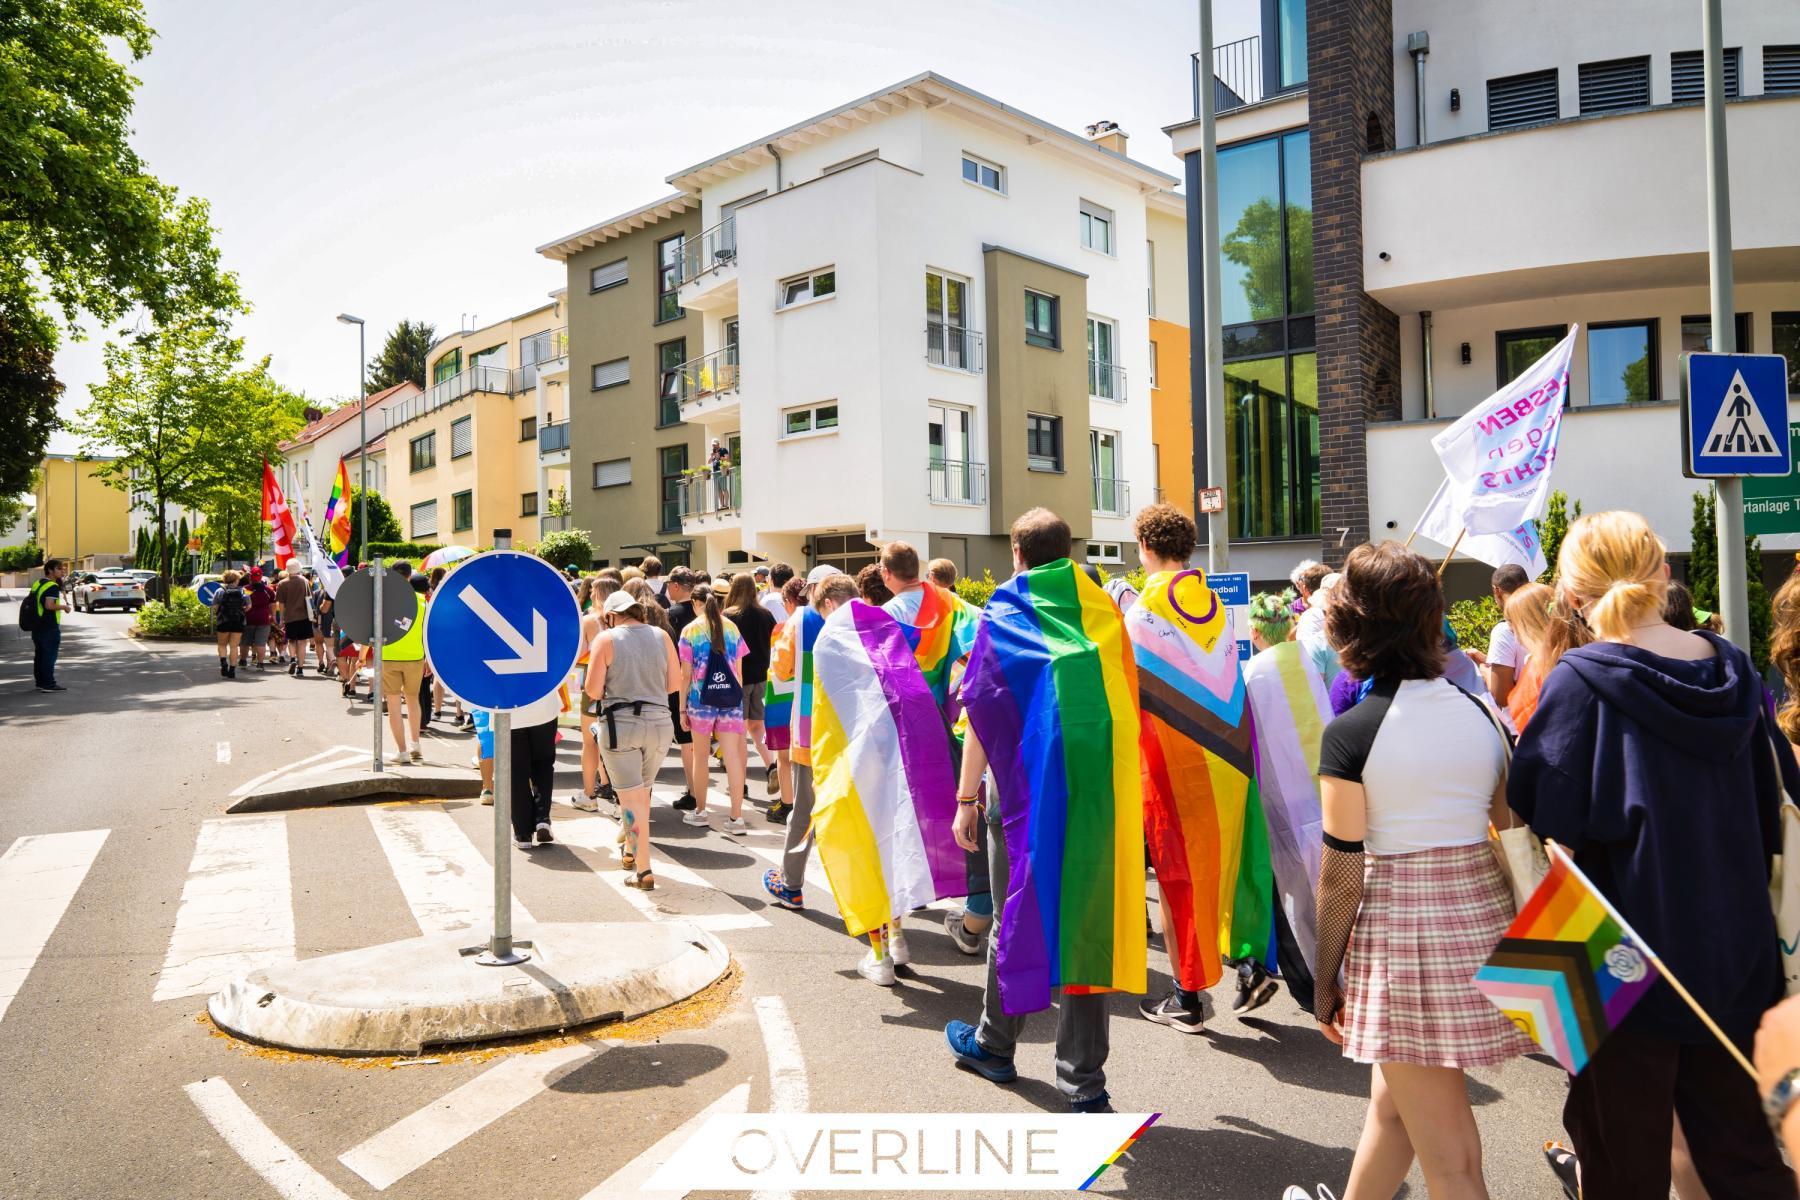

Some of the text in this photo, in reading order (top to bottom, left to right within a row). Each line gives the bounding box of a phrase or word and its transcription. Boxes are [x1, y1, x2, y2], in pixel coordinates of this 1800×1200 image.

[1744, 500, 1790, 514] rtanlage
[1336, 527, 1350, 547] 7
[1212, 586, 1239, 594] ndball
